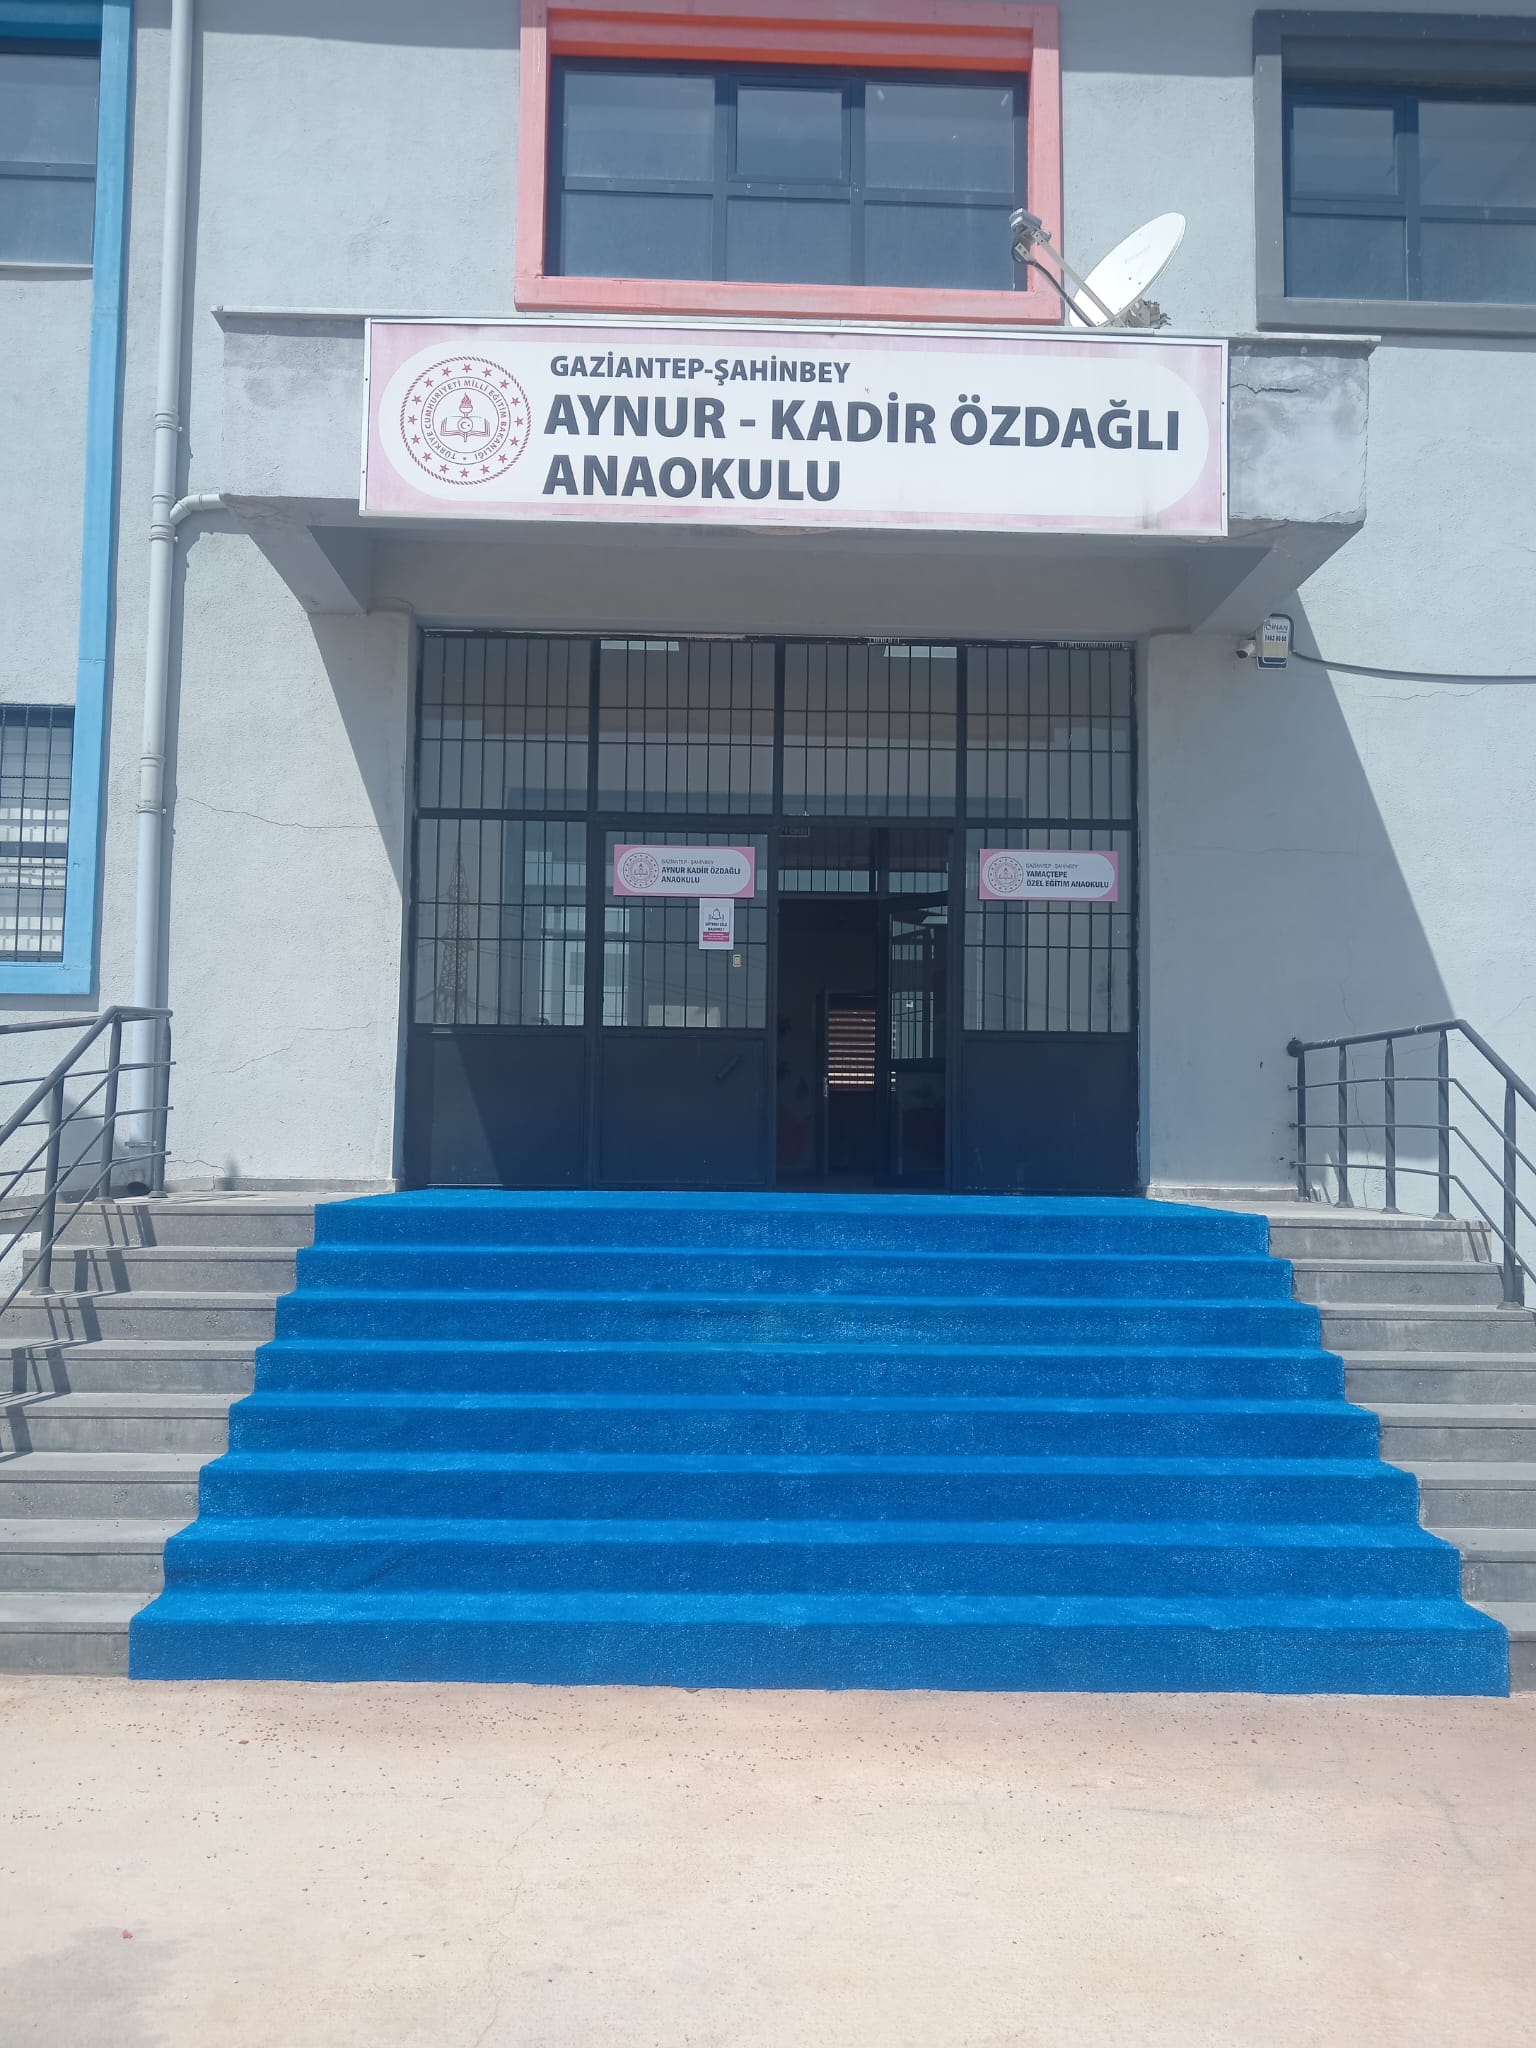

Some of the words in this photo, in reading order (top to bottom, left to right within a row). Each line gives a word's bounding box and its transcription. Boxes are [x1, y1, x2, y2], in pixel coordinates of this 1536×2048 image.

[550, 351, 851, 386] GAZİANTEP-ŞAHİNBEY
[464, 379, 489, 391] MİLLİ
[424, 380, 461, 429] CUMHURİYETİ
[489, 389, 507, 418] EĞİTİM
[544, 394, 726, 439] AYNUR
[739, 418, 756, 427] -
[771, 391, 937, 444] KADİR
[950, 393, 1179, 451] ÖZDAĞLI
[427, 431, 456, 460] TÜRKİYE
[474, 421, 508, 460] BAKANLIĞI
[542, 455, 840, 501] ANAOKULU
[710, 866, 741, 875] ÖZDAĞLI
[1026, 871, 1068, 879] YAMAÇTEPE
[1026, 879, 1044, 887] ÖZEL
[1045, 879, 1070, 887] EĞİTİM
[1071, 880, 1109, 888] ANAOKULU
